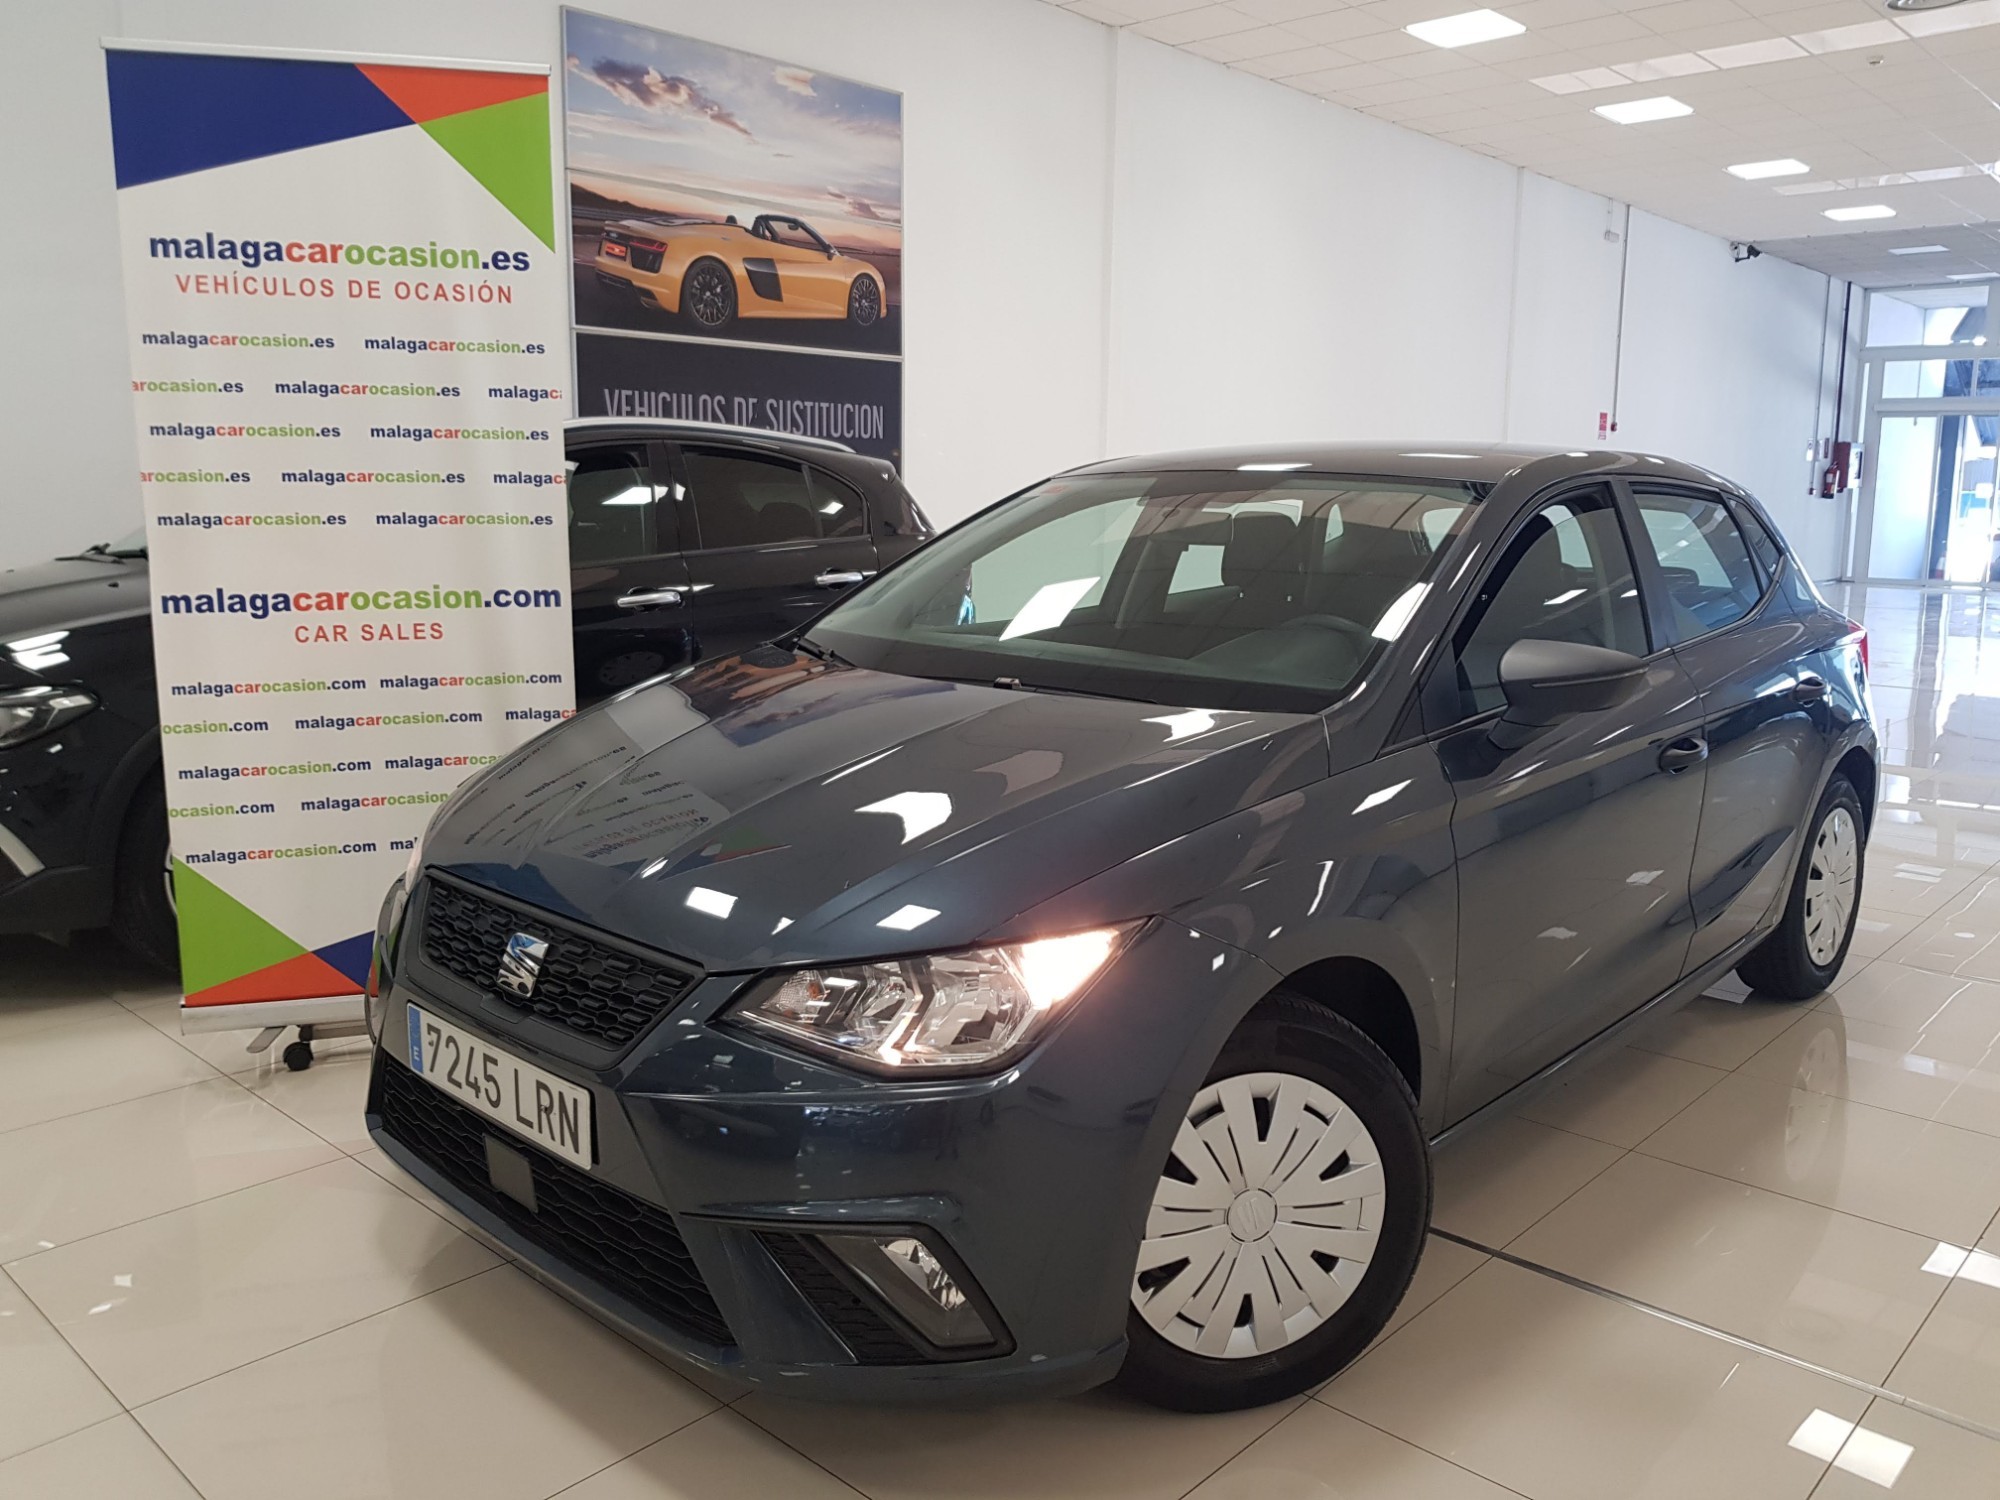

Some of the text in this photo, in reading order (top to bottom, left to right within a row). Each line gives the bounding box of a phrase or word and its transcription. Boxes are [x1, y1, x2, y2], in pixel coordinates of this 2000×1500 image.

[149, 231, 531, 272] malagacarocasion.es
[175, 270, 512, 304] VEHÍCULOS DE OCASIÓN
[141, 330, 546, 355] malagacarocasion.es malagacarocasion.es
[274, 380, 461, 398] malagacarocasion.es
[488, 384, 563, 403] malagac
[765, 398, 885, 440] SUSTITUCION
[149, 422, 550, 442] malagacarocasion.es malagacarocasion.es
[281, 468, 466, 487] malagacarocasion.es
[156, 511, 554, 530] malagacarocasion.es malagacarocasion.es
[160, 583, 562, 620] malagacarocasion.com
[294, 622, 444, 644] CAR SALES
[171, 671, 563, 698] malagacarocasion.com malagacarocasion.com
[162, 719, 269, 735] ocasion.com
[294, 711, 483, 731] malagacarocasion.com
[178, 760, 372, 781] malagacarocasion.com
[169, 803, 276, 818] ocasion.com
[182, 842, 377, 864] malagacarocasion.com
[426, 1022, 580, 1155] 7245 LRN
